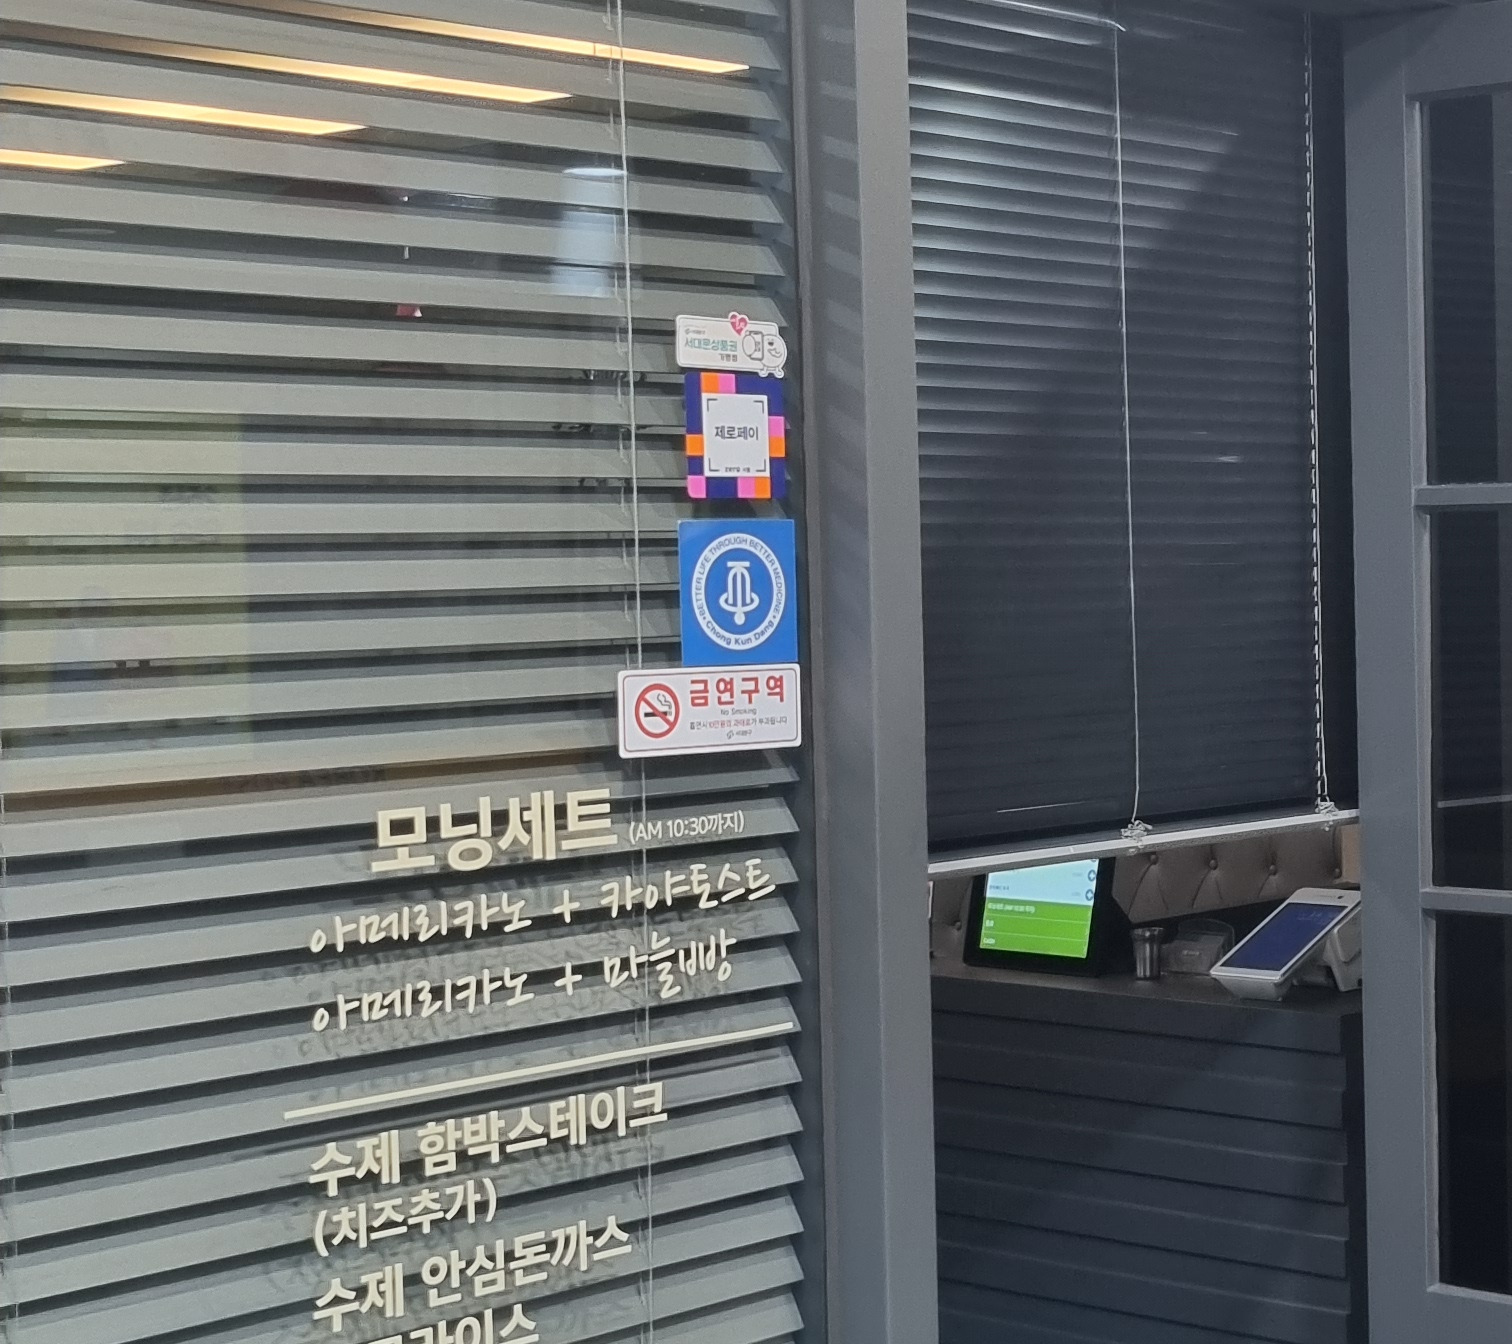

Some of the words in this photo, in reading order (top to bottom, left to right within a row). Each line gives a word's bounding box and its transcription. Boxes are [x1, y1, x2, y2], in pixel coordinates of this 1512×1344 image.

[714, 426, 758, 441] 제로페이
[709, 536, 748, 555] THROUGH
[749, 539, 776, 566] BETTER
[706, 621, 731, 645] Chong
[734, 637, 753, 645] Kun
[754, 620, 775, 640] Dang
[690, 675, 785, 707] 금연구역
[731, 708, 757, 716] Smoking
[370, 788, 618, 873] 모닝세트
[629, 821, 663, 845] (AM
[667, 810, 745, 838] 10:30까지)
[309, 893, 533, 954] 아메리카노
[552, 890, 580, 925] +
[601, 858, 776, 918] 카야토스트
[311, 967, 536, 1032] 아메리카노
[554, 964, 582, 995] +
[603, 929, 736, 999] 마늘빵
[308, 1129, 401, 1198] 수제
[417, 1081, 668, 1176] 함박스테이크
[312, 1177, 498, 1257] (치즈추가)
[313, 1263, 405, 1332] 수제
[422, 1215, 632, 1307] 안심돈까스
